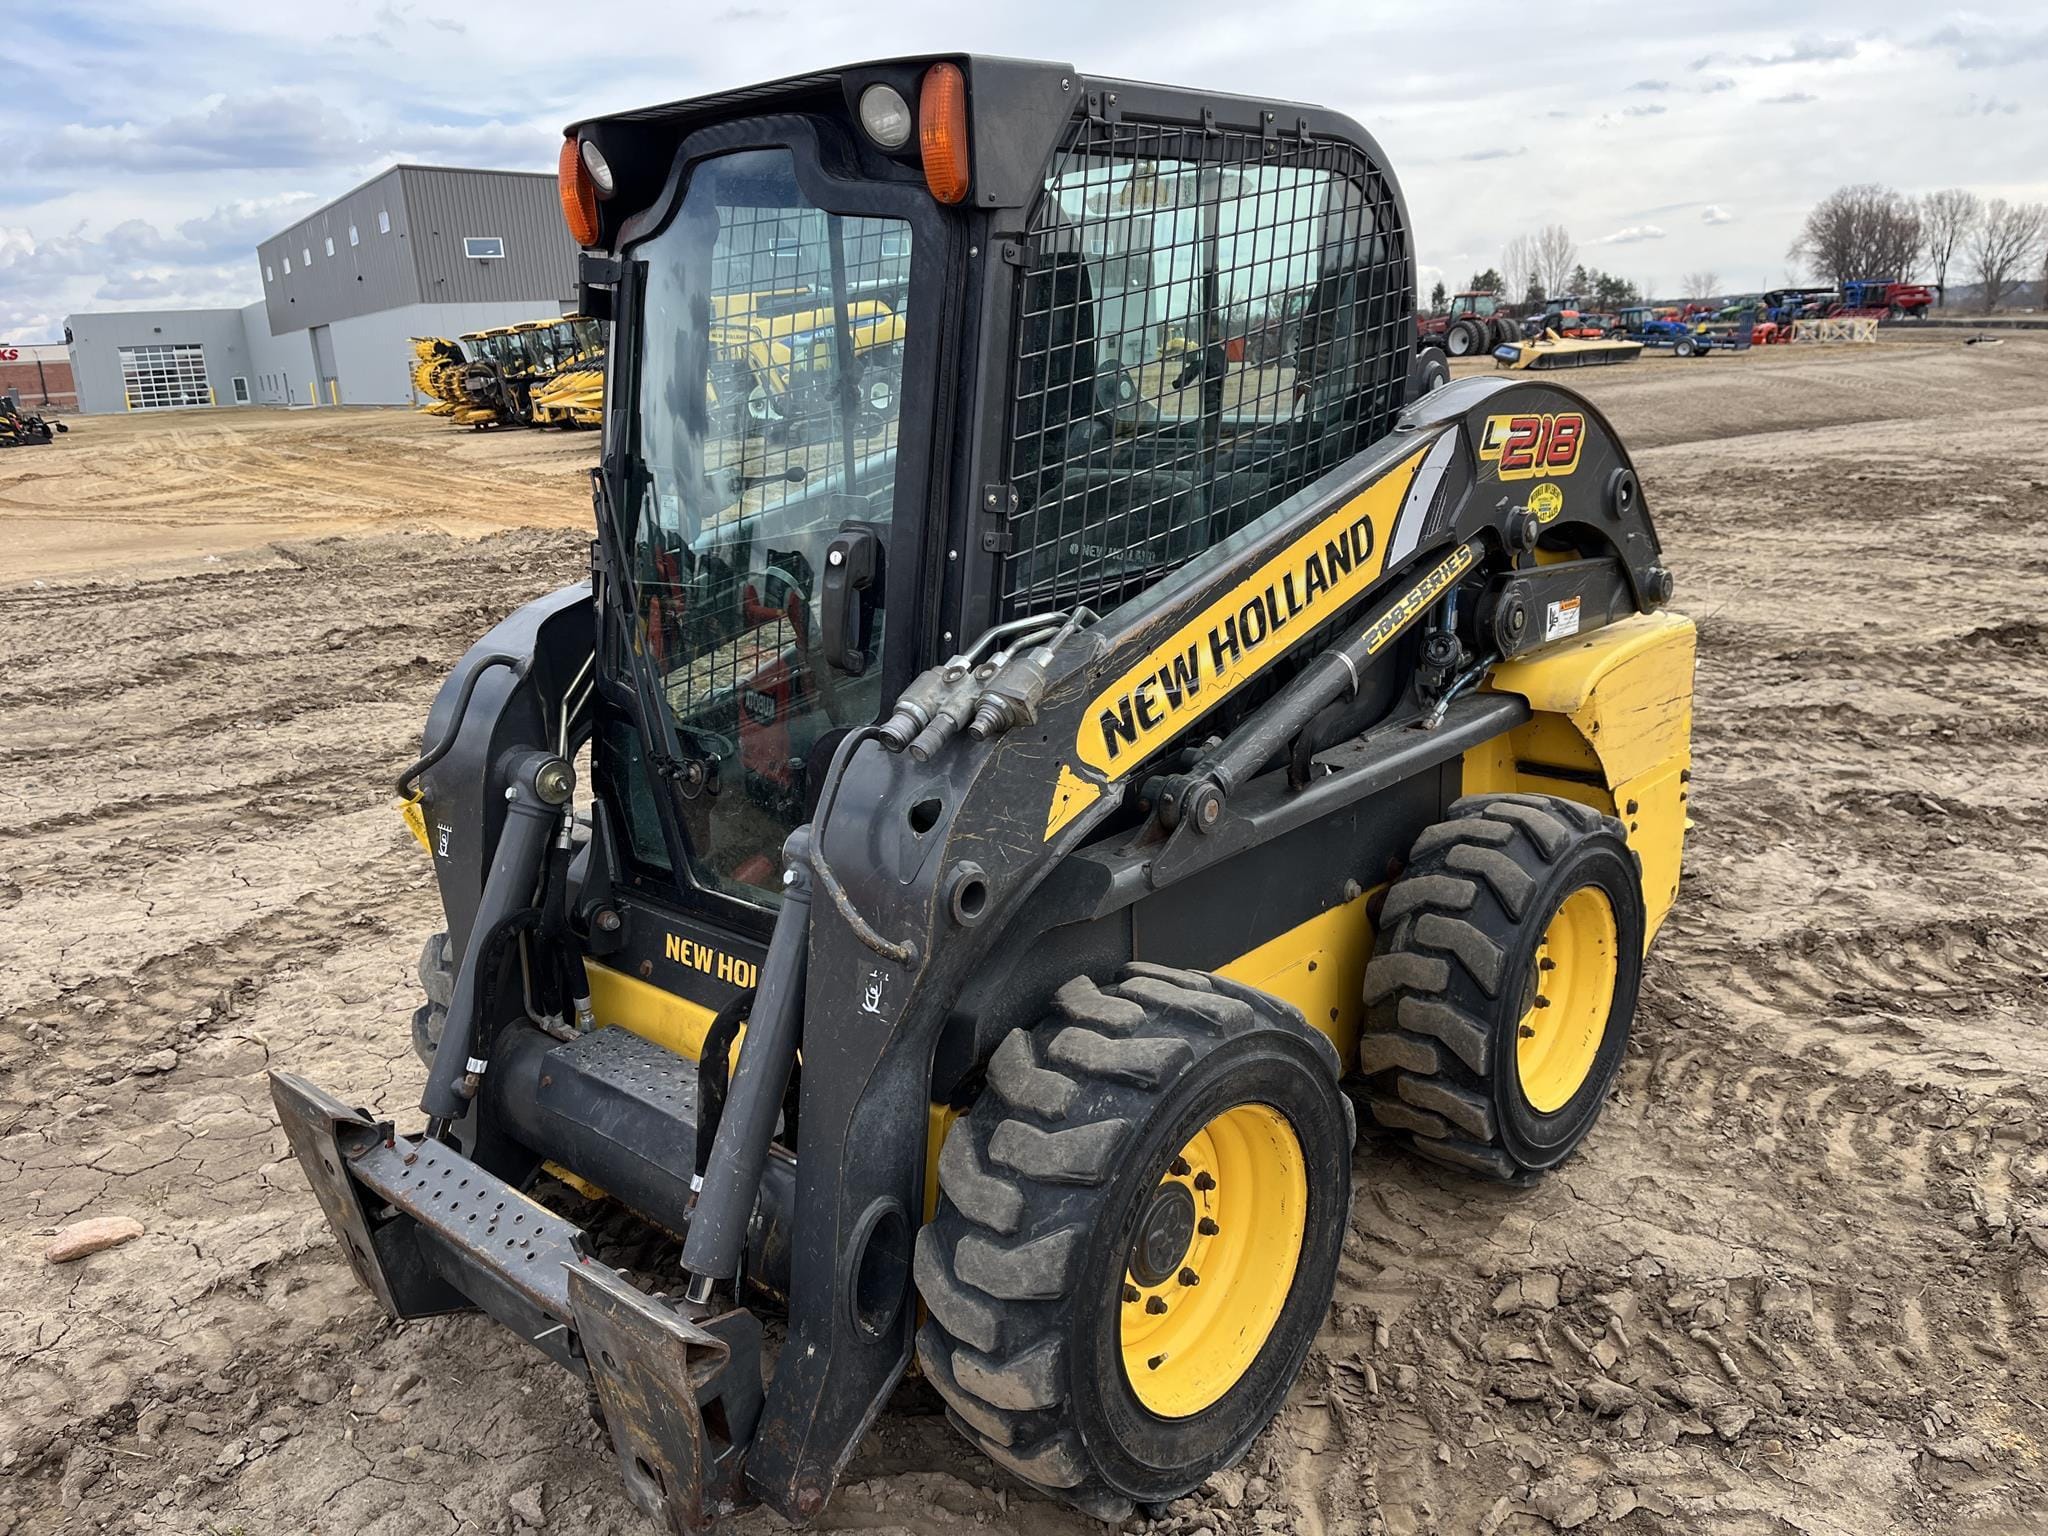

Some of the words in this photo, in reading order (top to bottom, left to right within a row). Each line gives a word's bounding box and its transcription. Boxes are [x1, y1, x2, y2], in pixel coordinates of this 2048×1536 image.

[1481, 414, 1584, 474] L218
[1100, 641, 1200, 761] NEW
[1207, 514, 1375, 677] HOLLAND
[665, 932, 714, 975] NEW
